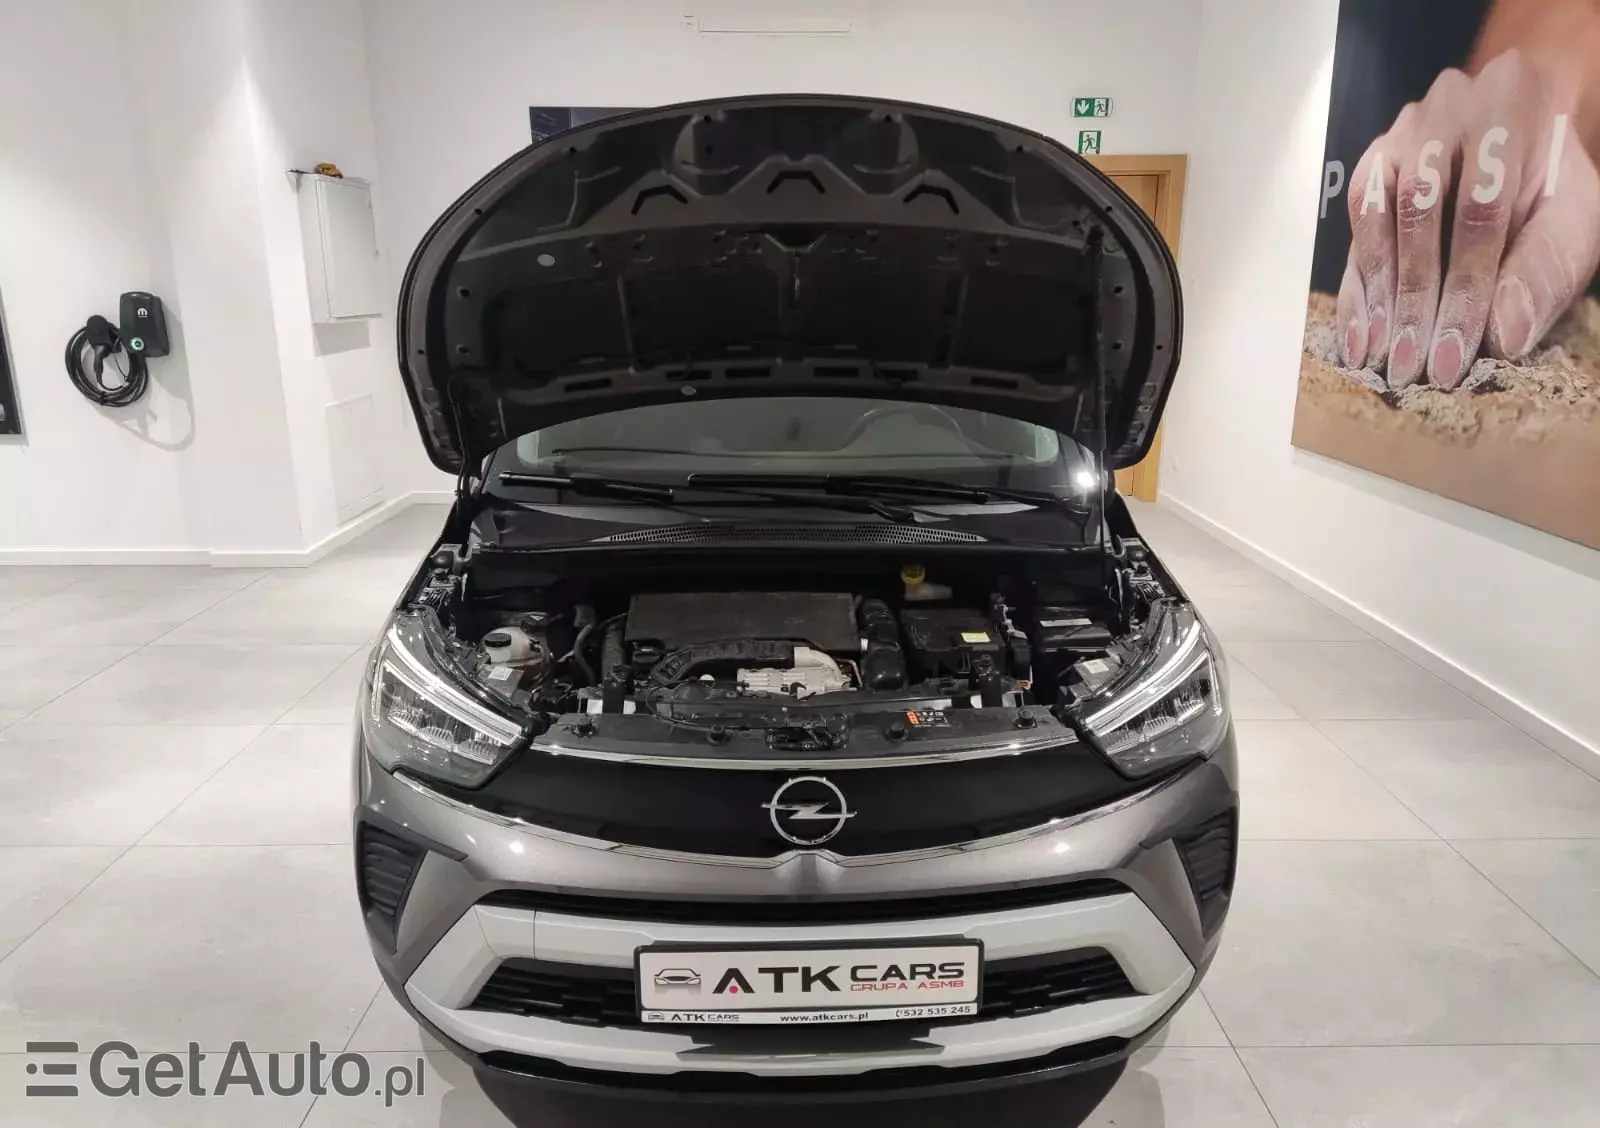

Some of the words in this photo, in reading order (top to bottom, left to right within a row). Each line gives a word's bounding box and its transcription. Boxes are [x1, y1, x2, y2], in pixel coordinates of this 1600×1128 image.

[711, 965, 842, 995] ATK
[850, 961, 966, 983] CARS
[850, 982, 909, 992] GRUPA
[903, 1009, 924, 1017] 532
[927, 1007, 948, 1016] 535
[950, 1005, 972, 1014] 245
[671, 1013, 706, 1022] ATK
[780, 1012, 869, 1023] www.atkcars.pl
